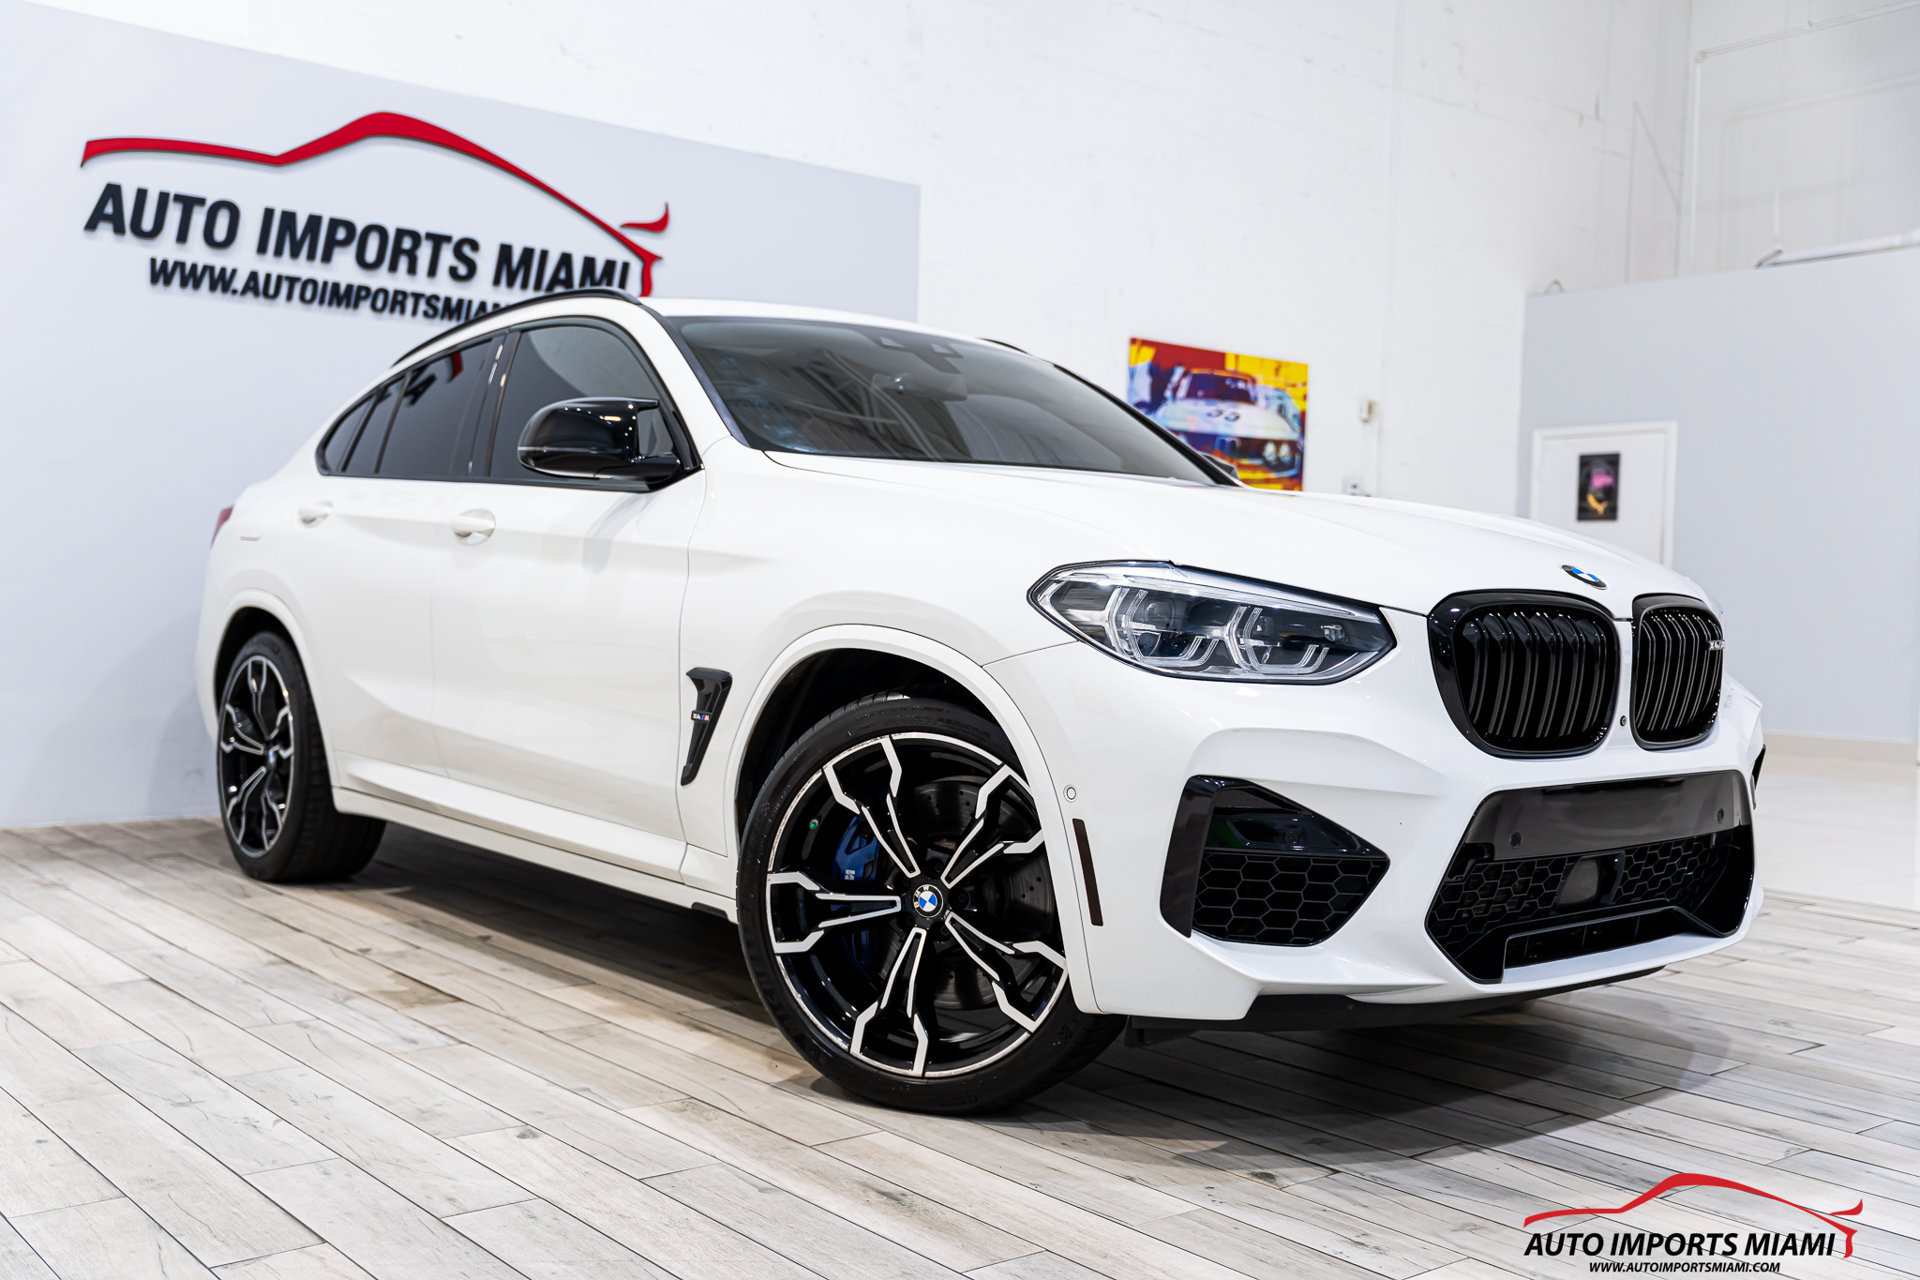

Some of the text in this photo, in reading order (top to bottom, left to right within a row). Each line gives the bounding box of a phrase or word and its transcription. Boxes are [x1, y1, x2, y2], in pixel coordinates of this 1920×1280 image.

[84, 183, 630, 293] AUTO IMPORTS MIAMI
